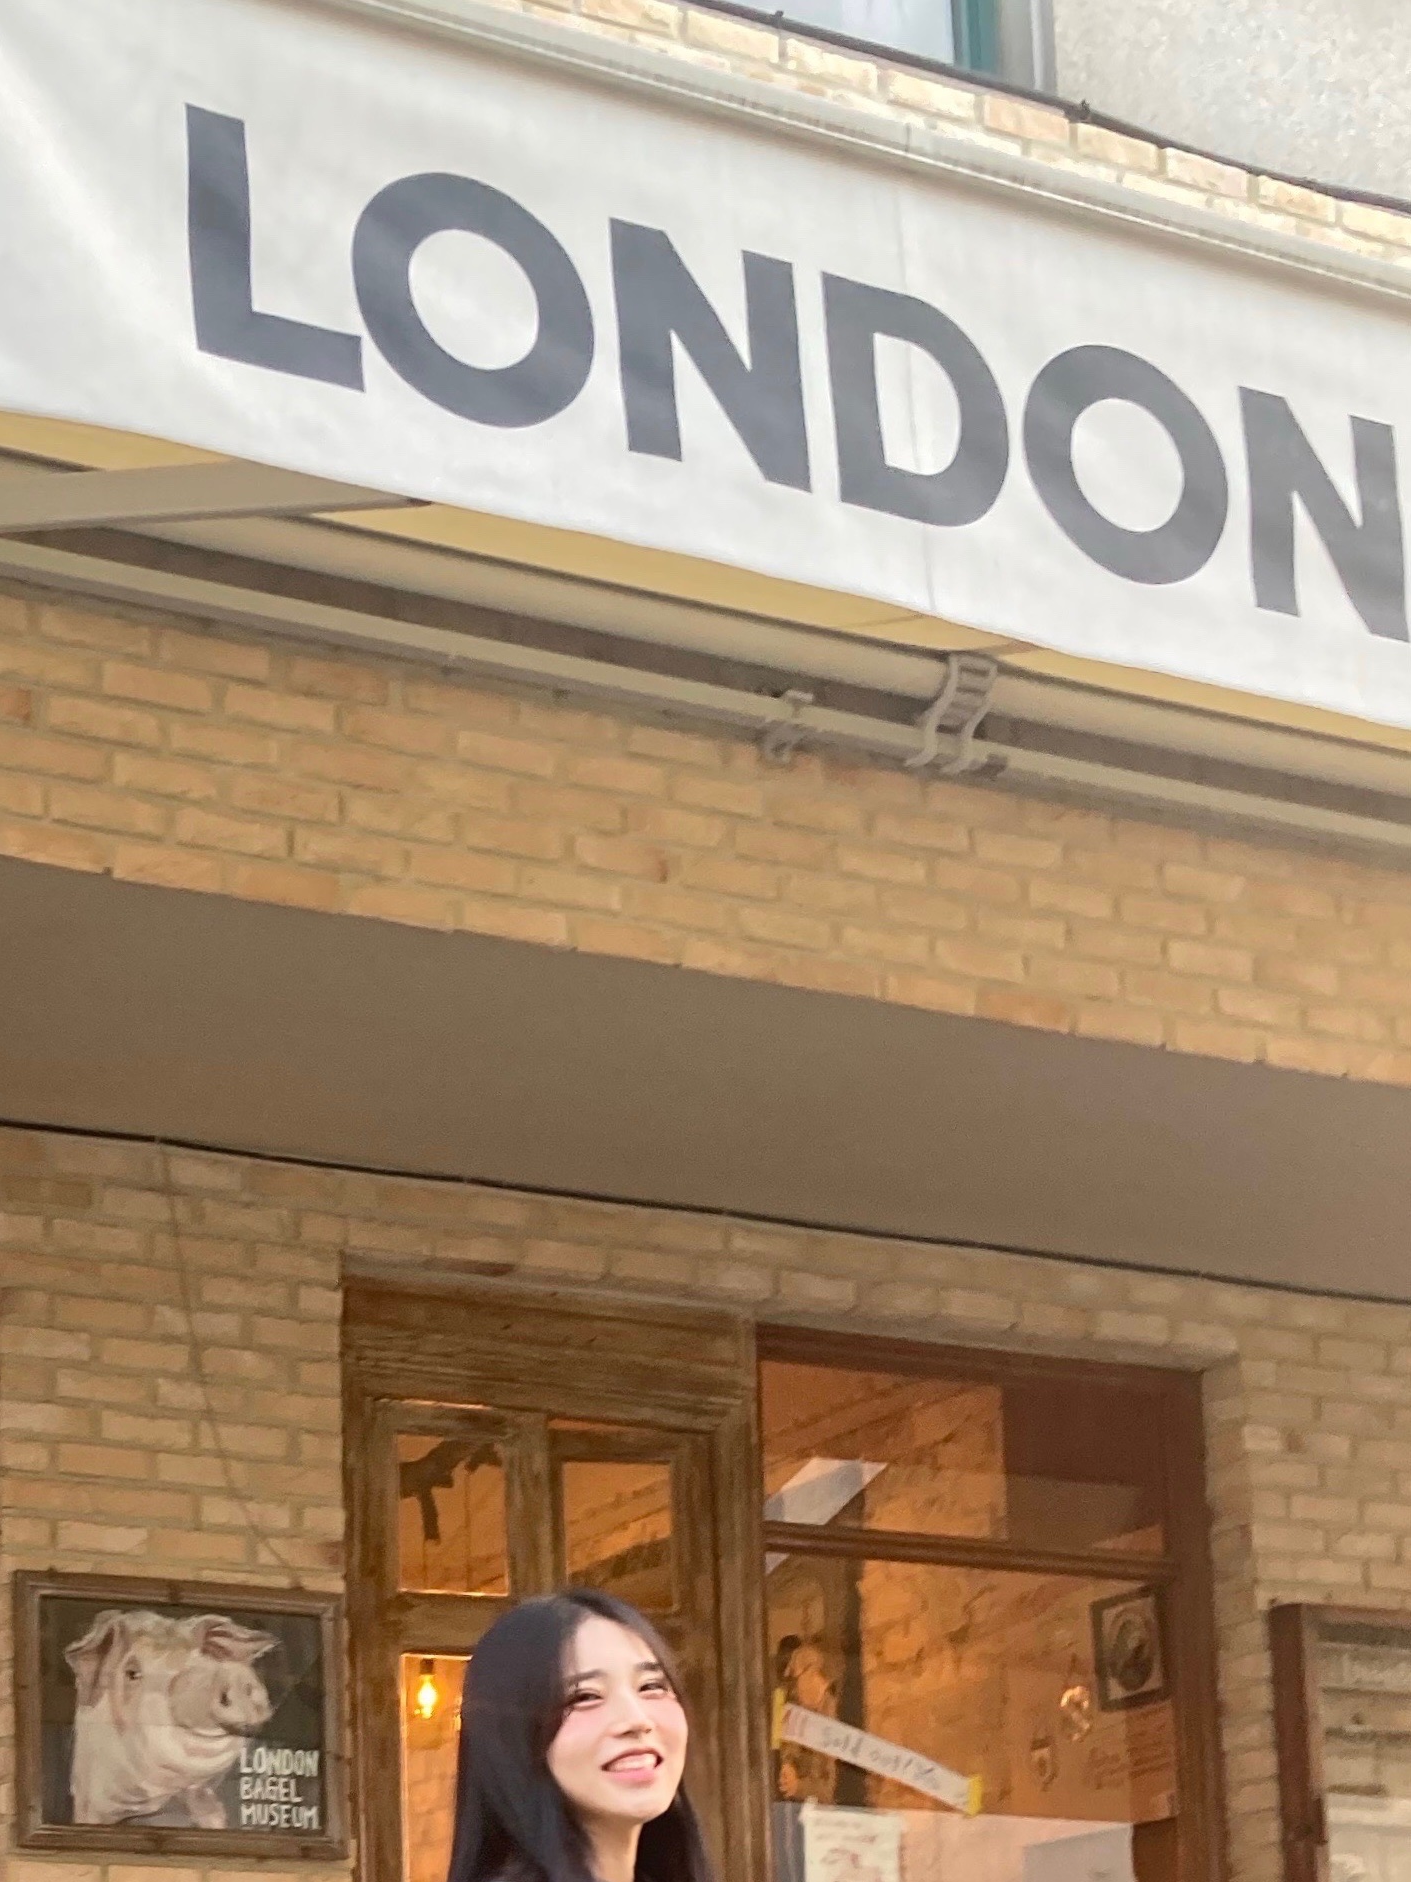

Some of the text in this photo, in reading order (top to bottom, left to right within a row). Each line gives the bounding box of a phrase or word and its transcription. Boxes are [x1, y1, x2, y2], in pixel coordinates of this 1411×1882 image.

[185, 102, 1410, 643] LONDON
[240, 1747, 320, 1777] LONDON
[240, 1776, 303, 1803] BAGEL
[240, 1803, 322, 1830] MUSEUM
